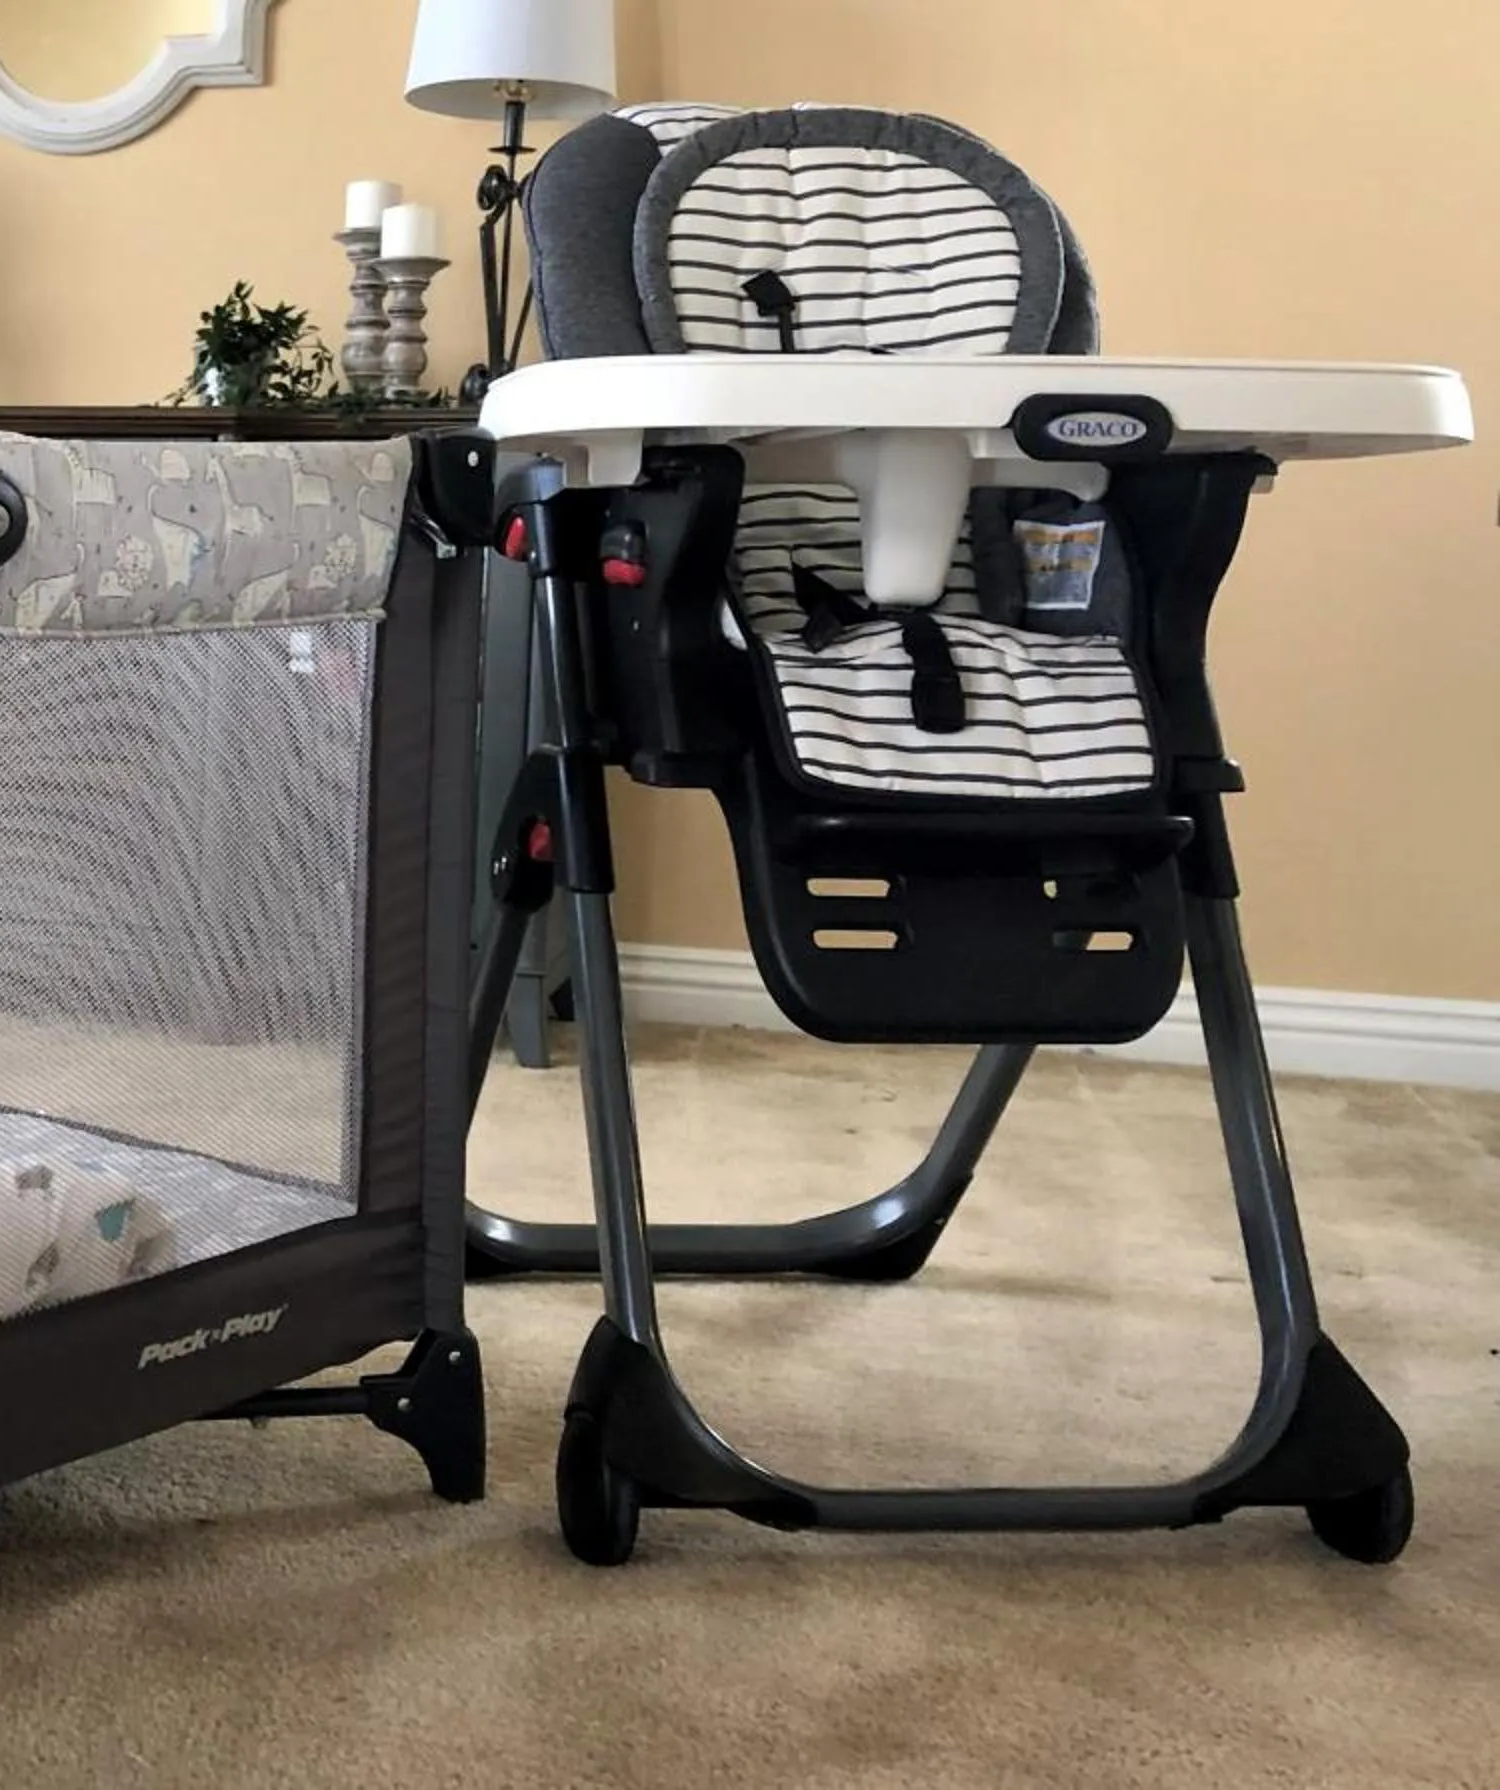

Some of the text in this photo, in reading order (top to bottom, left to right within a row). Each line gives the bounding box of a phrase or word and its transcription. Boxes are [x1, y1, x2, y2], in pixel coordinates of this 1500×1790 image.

[1058, 419, 1138, 438] GRACO
[138, 1307, 282, 1370] Pack Play
